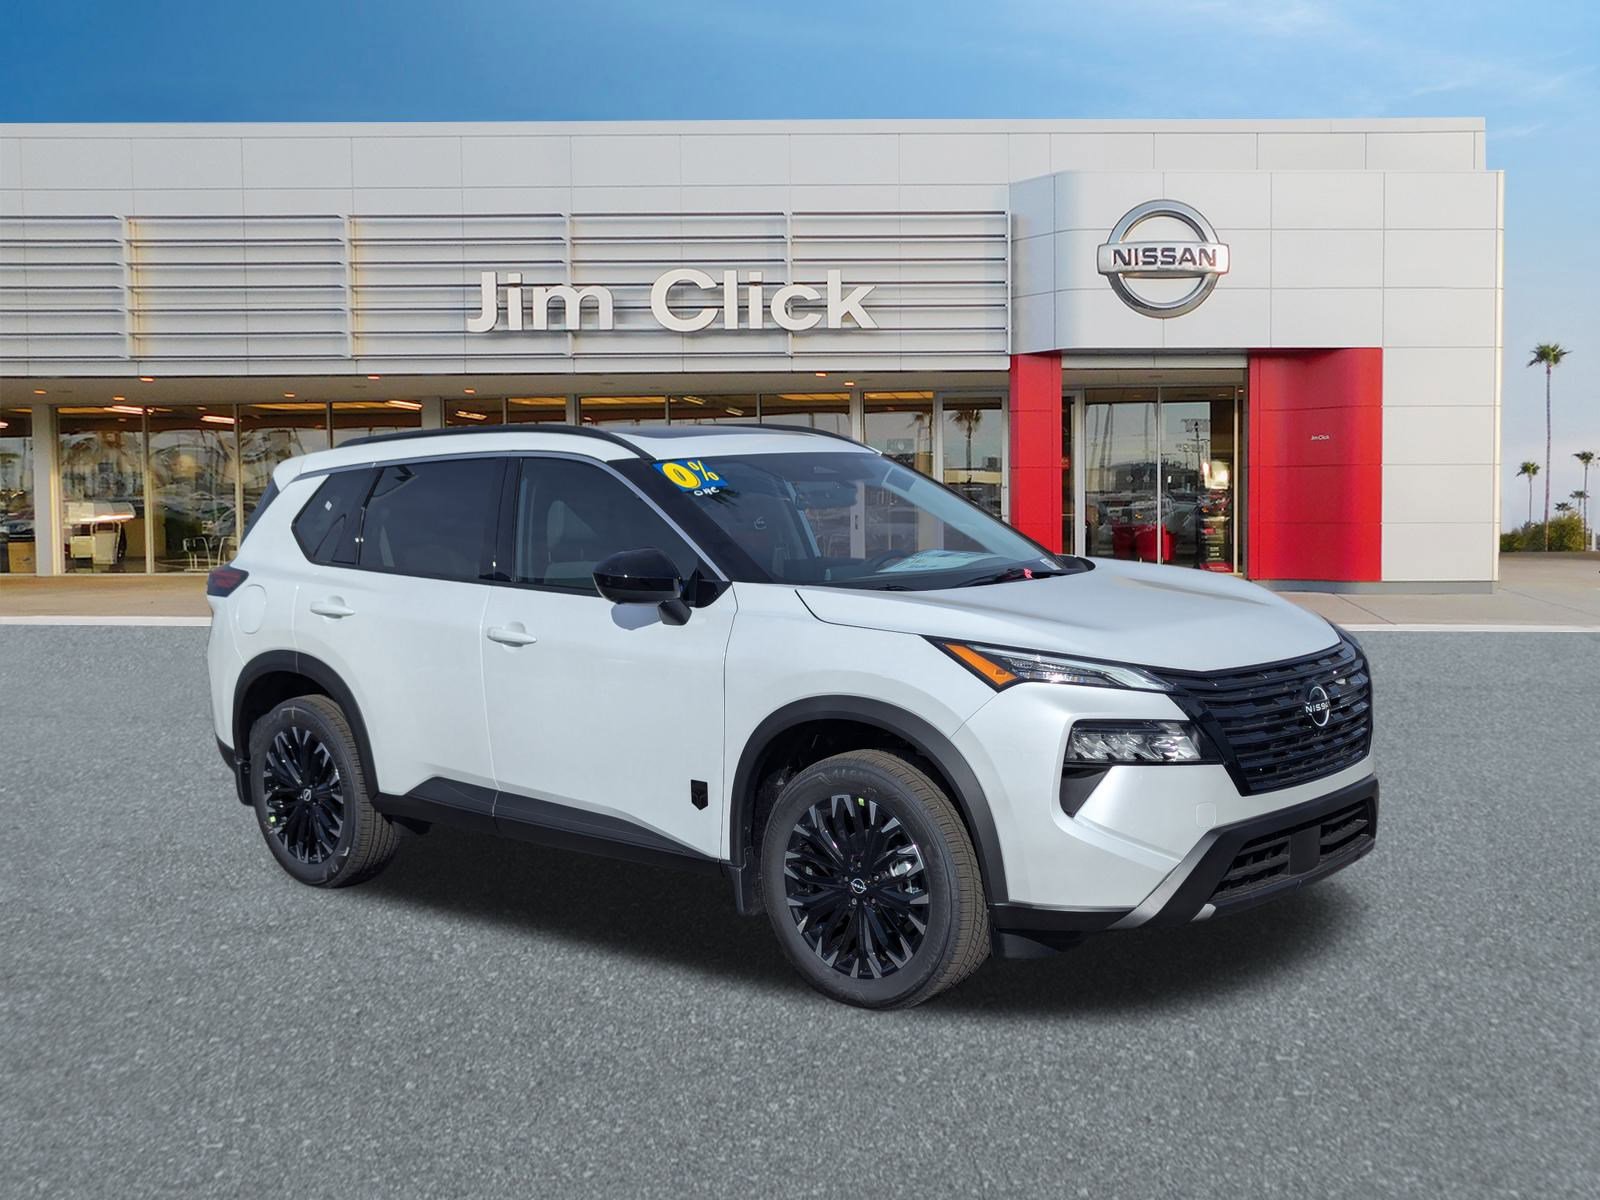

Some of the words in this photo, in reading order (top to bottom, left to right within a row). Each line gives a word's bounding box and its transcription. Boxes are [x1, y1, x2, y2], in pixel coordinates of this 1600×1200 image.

[1112, 247, 1217, 267] NISSAN
[467, 271, 613, 333] Jim
[650, 269, 879, 332] Click
